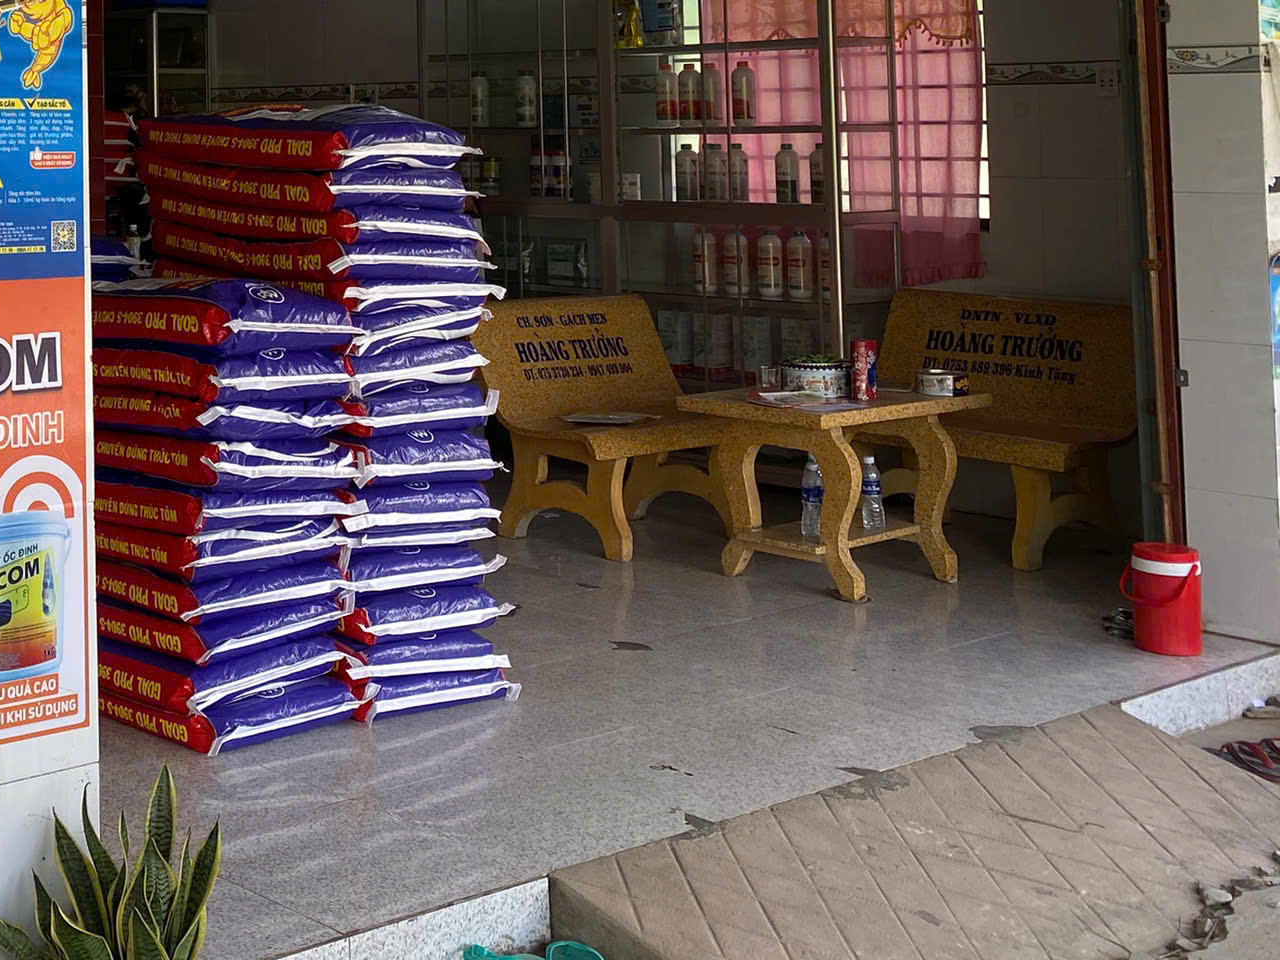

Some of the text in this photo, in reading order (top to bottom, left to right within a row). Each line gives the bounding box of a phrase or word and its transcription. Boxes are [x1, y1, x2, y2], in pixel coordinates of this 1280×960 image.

[171, 314, 199, 333] GOAL
[587, 313, 608, 325] MEN
[514, 327, 629, 363] HOÀNG TRƯỞNG
[925, 322, 1083, 362] HOÀNG TRƯỞNG
[153, 631, 182, 653] GOAL
[34, 678, 56, 694] CAO
[6, 708, 27, 724] KHI
